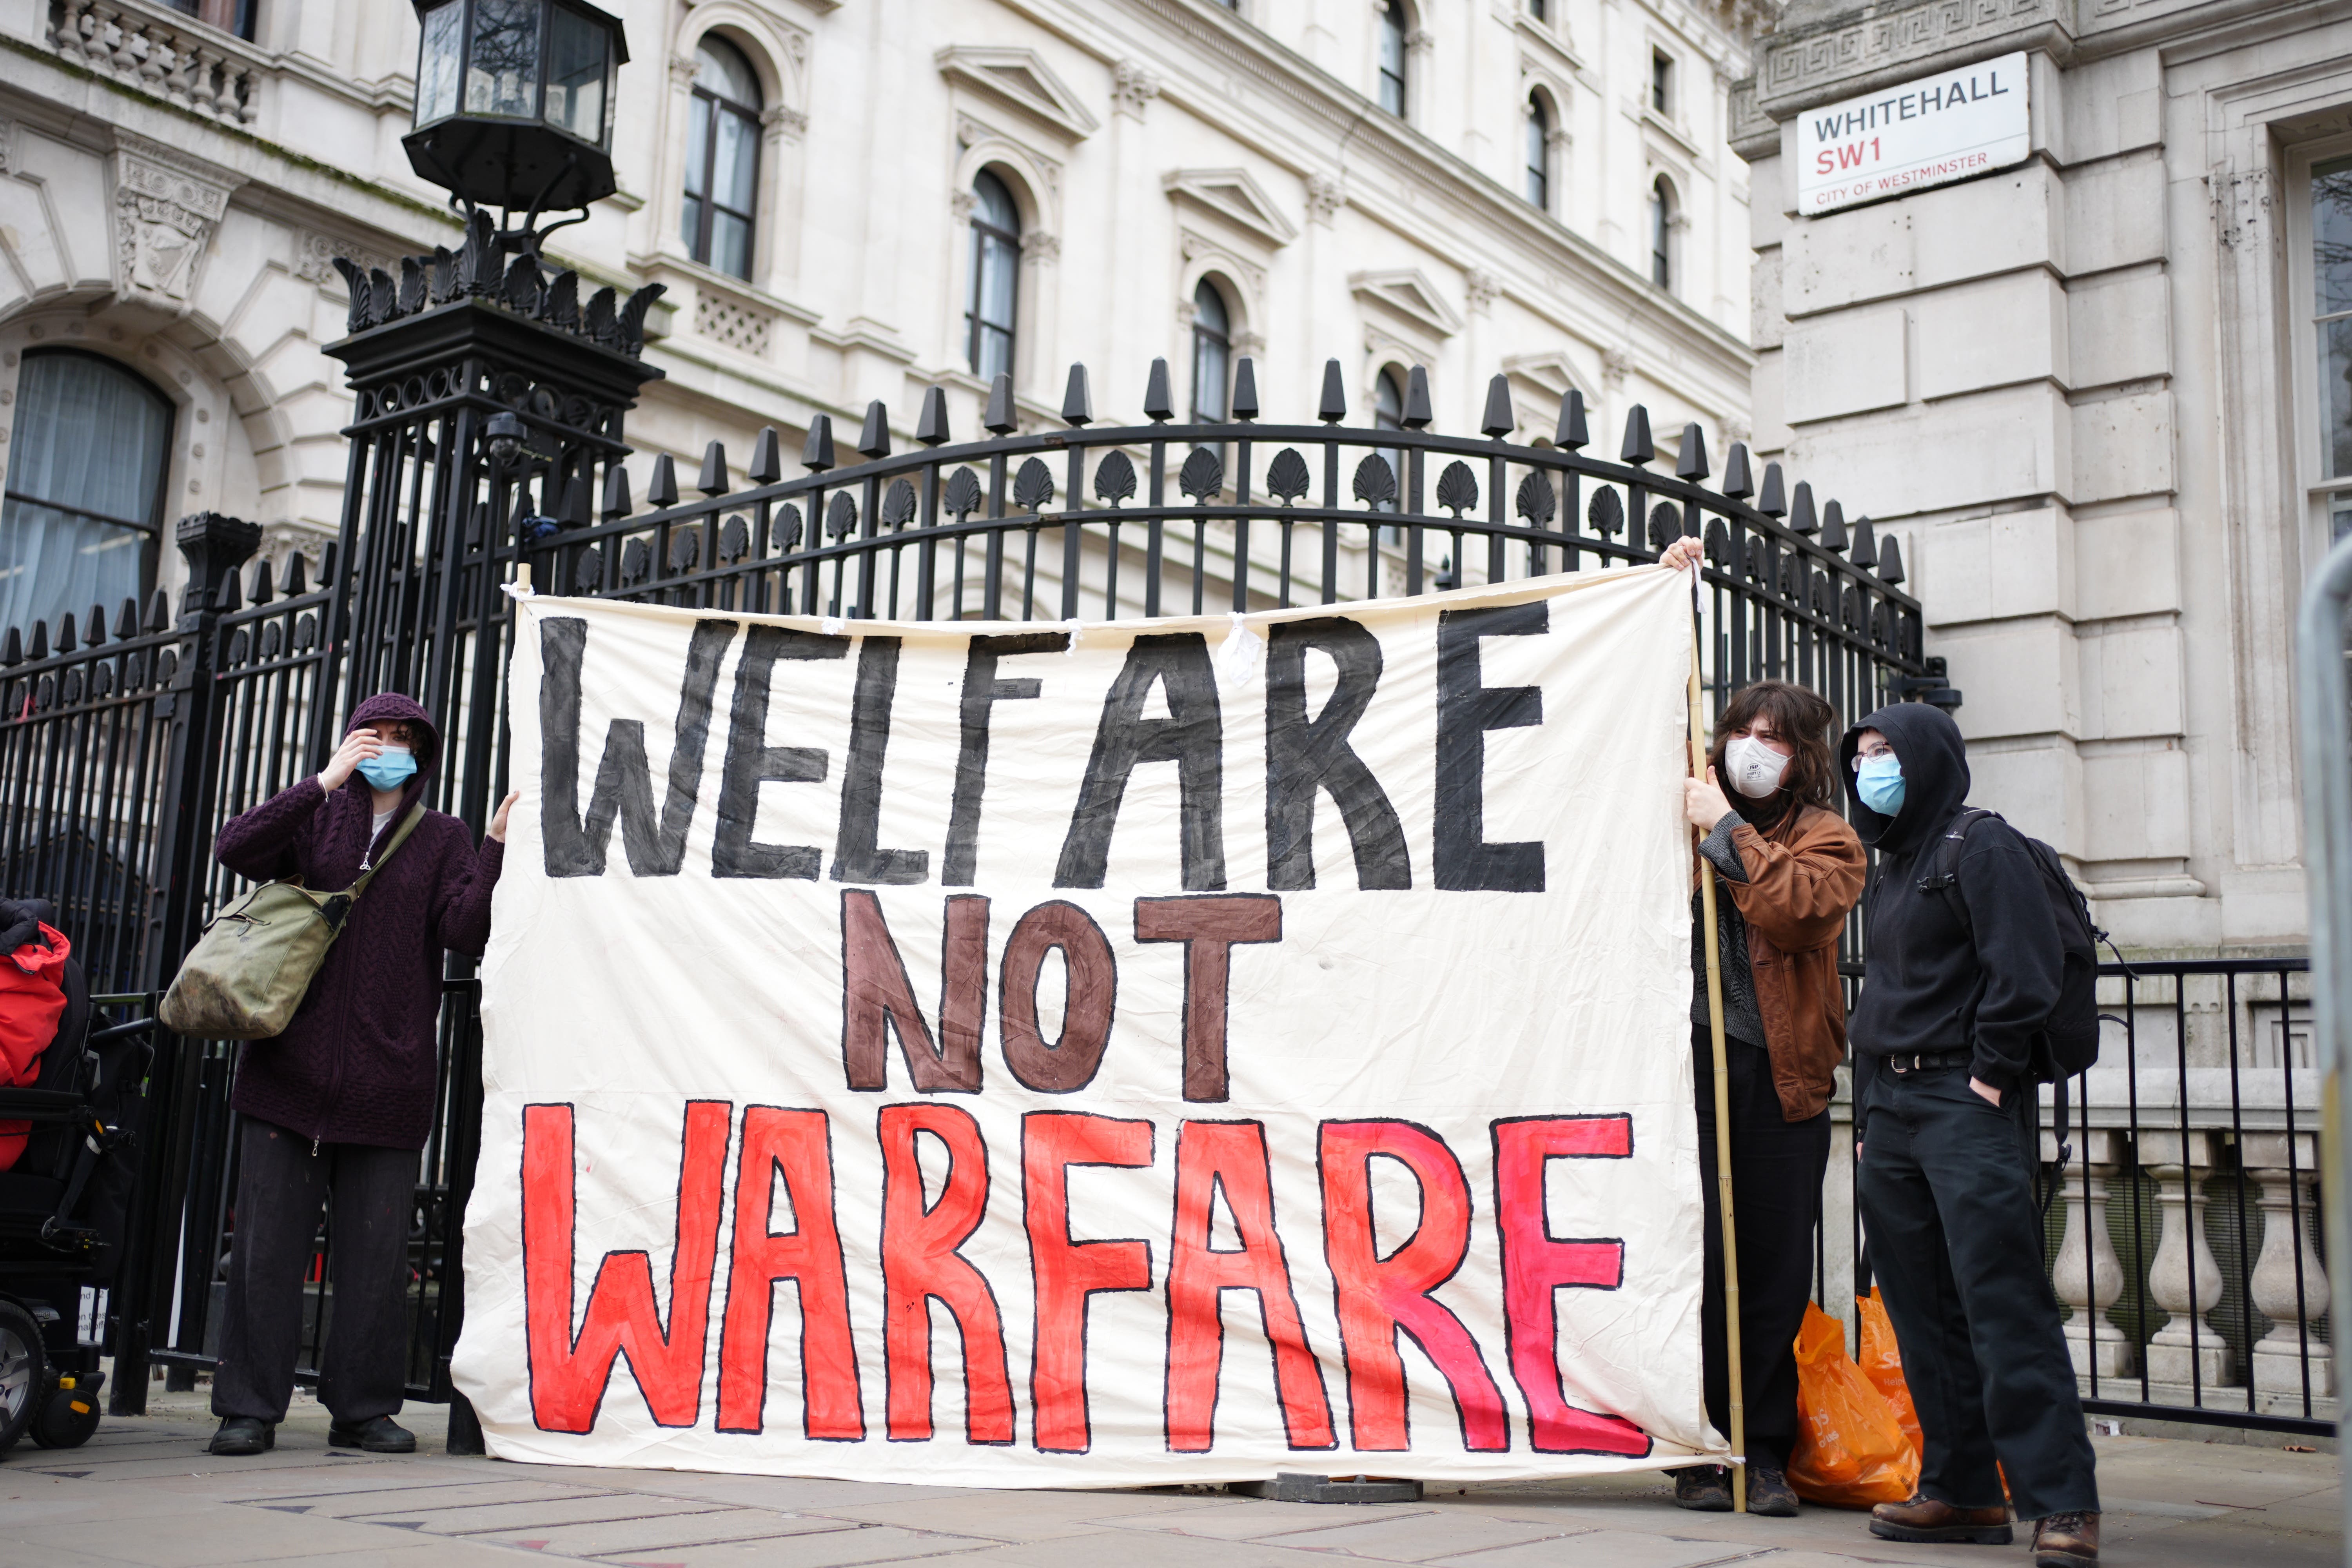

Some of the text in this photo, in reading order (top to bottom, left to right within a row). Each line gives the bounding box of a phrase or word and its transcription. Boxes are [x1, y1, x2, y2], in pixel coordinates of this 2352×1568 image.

[1815, 71, 2009, 142] WHITEHALL
[1817, 137, 1880, 175] SW1
[1816, 152, 1987, 205] CITY OF WESTMINSTER
[539, 599, 1549, 893] WELFARE
[840, 888, 1282, 1103] NOT
[522, 1099, 1653, 1459] WARFARE
